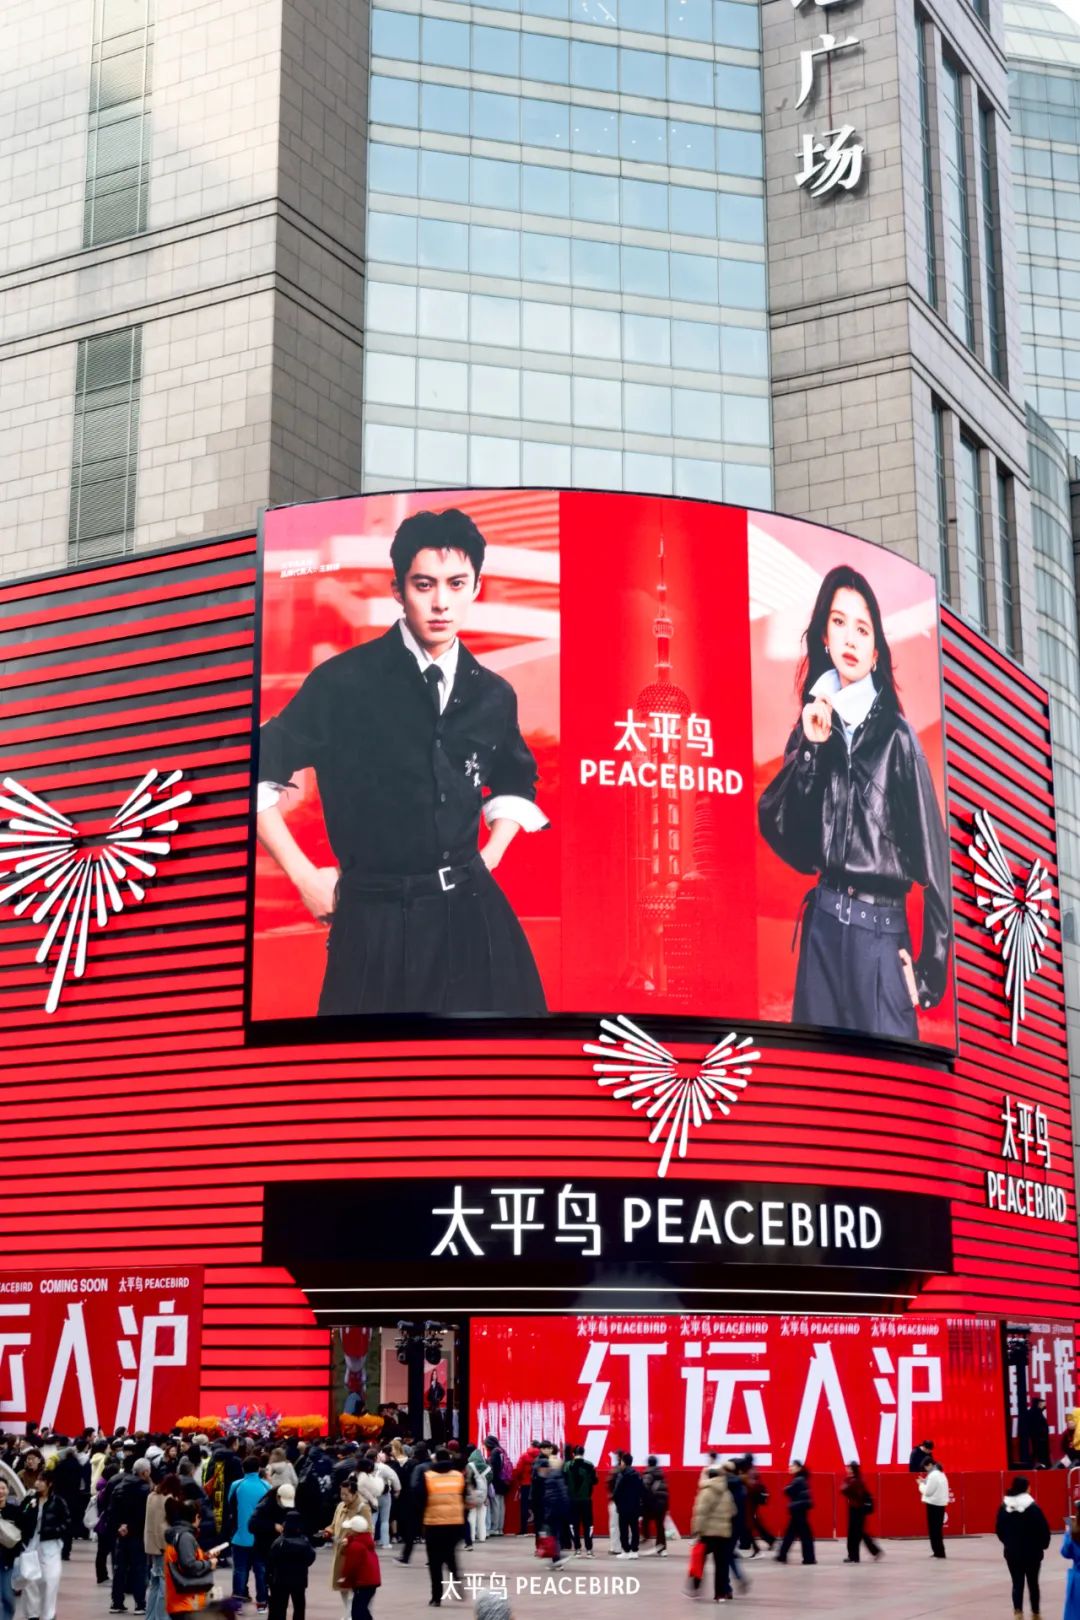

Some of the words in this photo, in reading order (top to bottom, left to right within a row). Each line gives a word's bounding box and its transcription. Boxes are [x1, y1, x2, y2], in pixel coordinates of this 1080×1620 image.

[790, 0, 865, 198] 广场
[613, 708, 714, 757] 太平鸟
[580, 758, 743, 795] PEACEBIRD
[1001, 1095, 1052, 1169] 太平鸟
[987, 1171, 1067, 1223] PEACEBIRD
[430, 1183, 602, 1256] 太平鸟
[624, 1198, 883, 1249] PEACEBIRD
[40, 1279, 78, 1293] COMING
[80, 1278, 108, 1292] SOON
[118, 1276, 143, 1292] 太平鸟
[144, 1277, 190, 1289] PEACEBIRD
[610, 1322, 667, 1335] PEACEBIRD
[713, 1322, 769, 1335] PEACEBIRD
[810, 1323, 860, 1335] PEACEBIRD
[897, 1324, 940, 1336] PEACEBIRD
